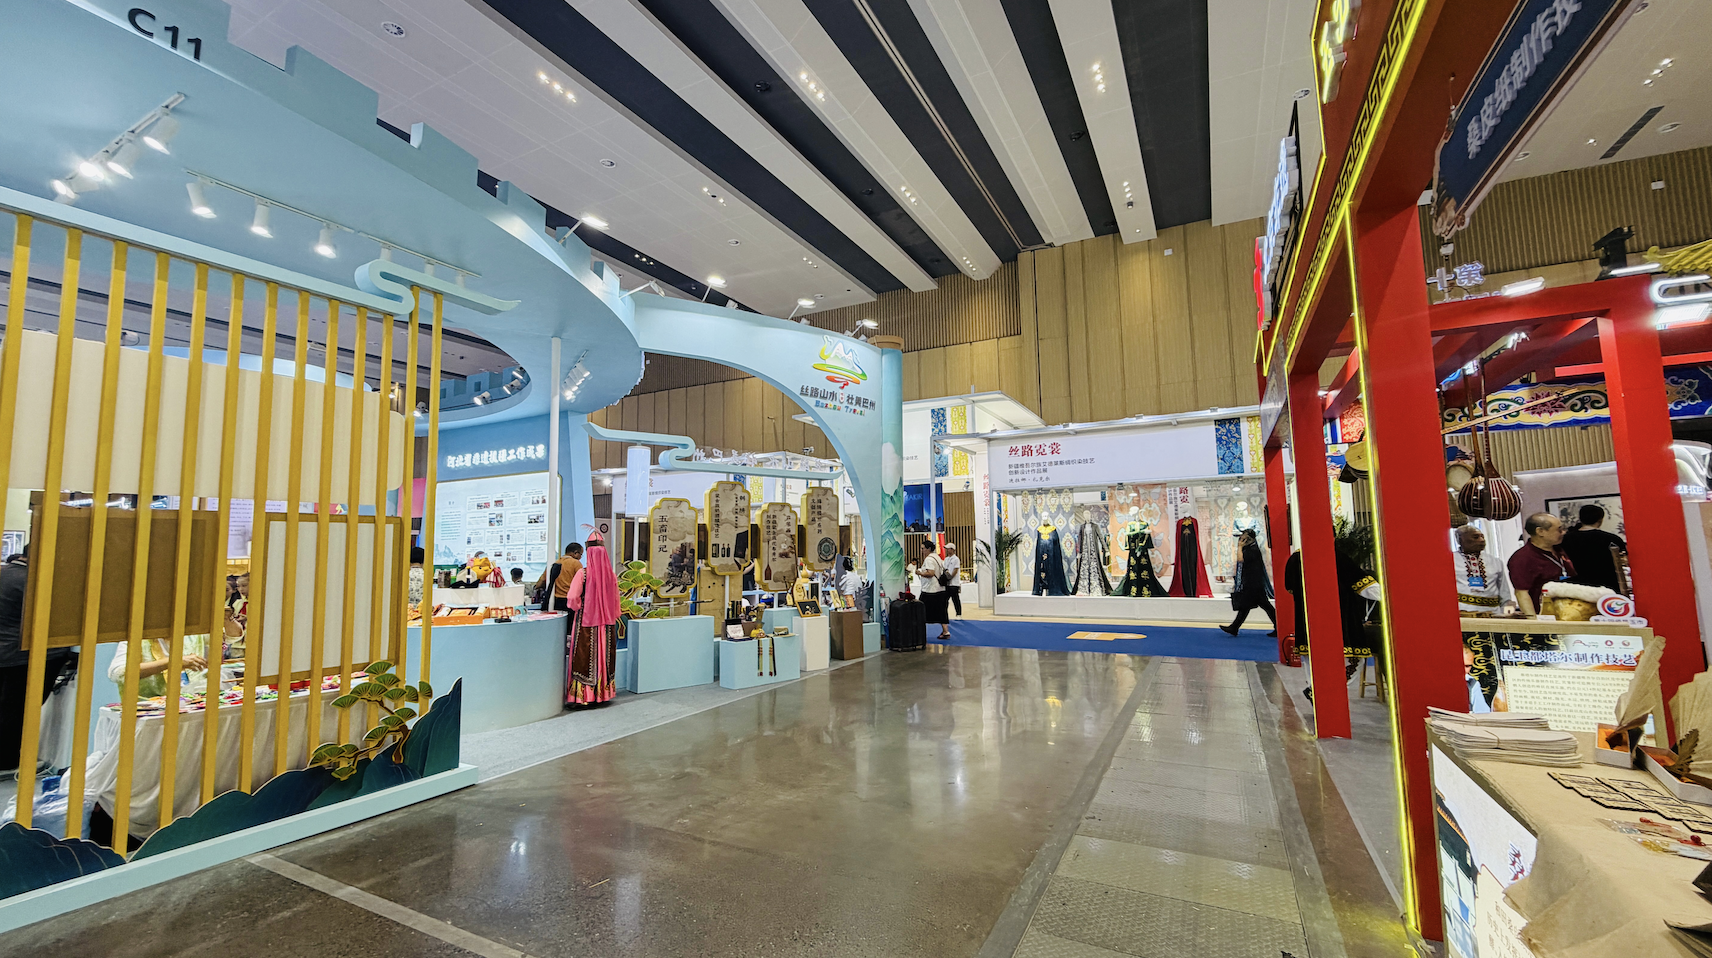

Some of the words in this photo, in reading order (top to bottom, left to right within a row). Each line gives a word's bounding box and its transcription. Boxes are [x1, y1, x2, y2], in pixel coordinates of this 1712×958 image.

[128, 8, 202, 61] C11
[800, 385, 837, 402] 丝路山水
[1008, 442, 1061, 457] 丝路霓裳
